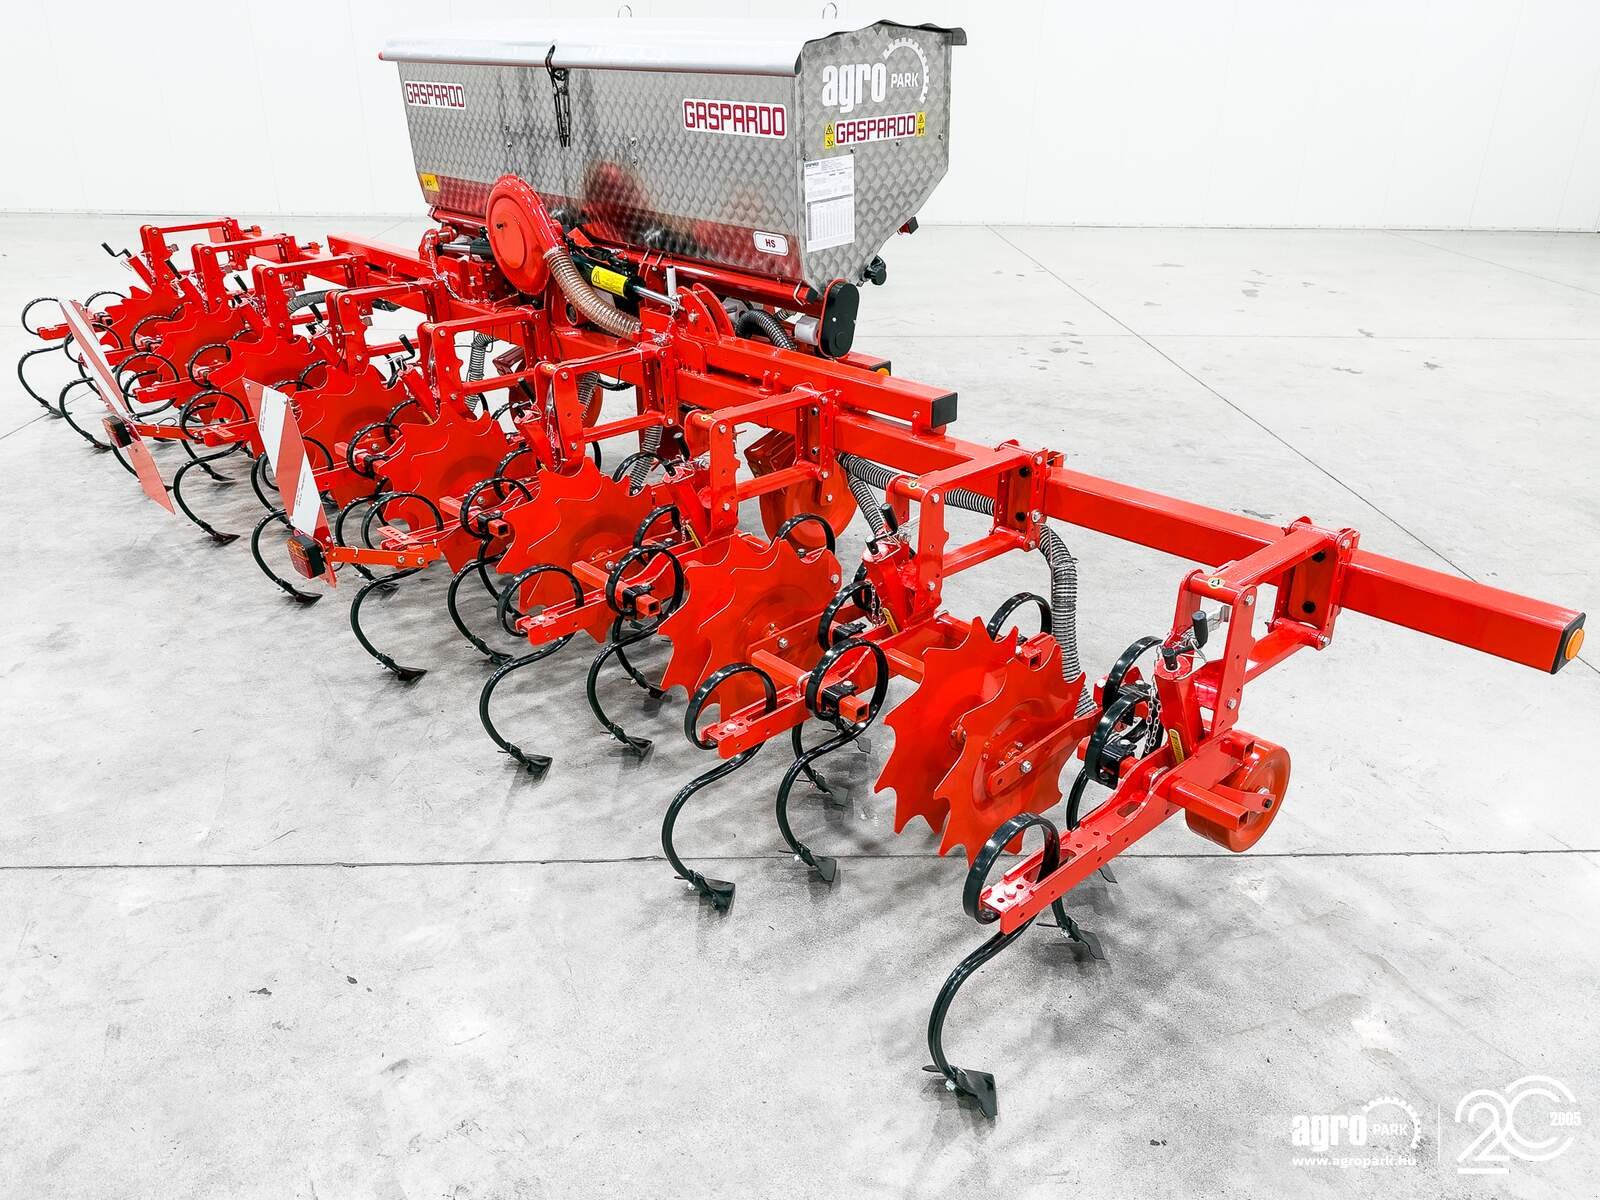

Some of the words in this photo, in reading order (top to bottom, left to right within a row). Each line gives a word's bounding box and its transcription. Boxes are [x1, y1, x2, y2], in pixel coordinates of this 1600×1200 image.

[405, 82, 465, 108] GASPARDO
[822, 62, 886, 114] agro
[890, 72, 919, 89] PARK
[684, 101, 785, 136] GASPARDO
[836, 115, 916, 144] GASPARDO
[765, 238, 776, 248] HS
